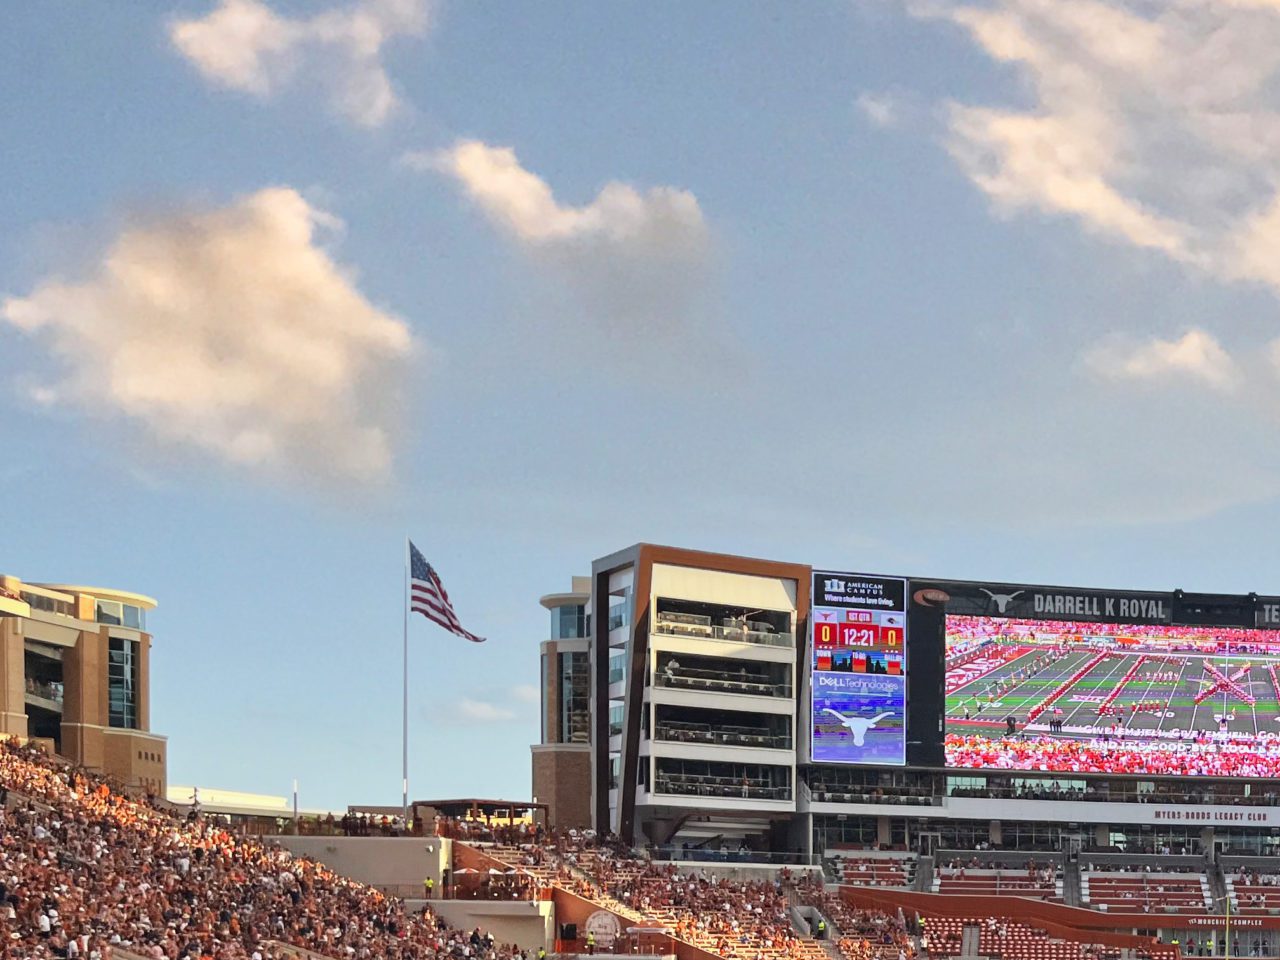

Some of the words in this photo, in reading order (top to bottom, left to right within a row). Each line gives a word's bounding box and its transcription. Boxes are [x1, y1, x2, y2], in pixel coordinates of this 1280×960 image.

[1034, 594, 1100, 615] DARRELL
[1105, 598, 1115, 617] K
[1119, 599, 1166, 619] ROYAL
[821, 625, 830, 642] 0
[843, 628, 874, 647] 12:21
[888, 630, 897, 647] 0
[819, 677, 845, 687] DELL
[1214, 812, 1244, 821] LEGACY
[1247, 813, 1267, 822] CLUB
